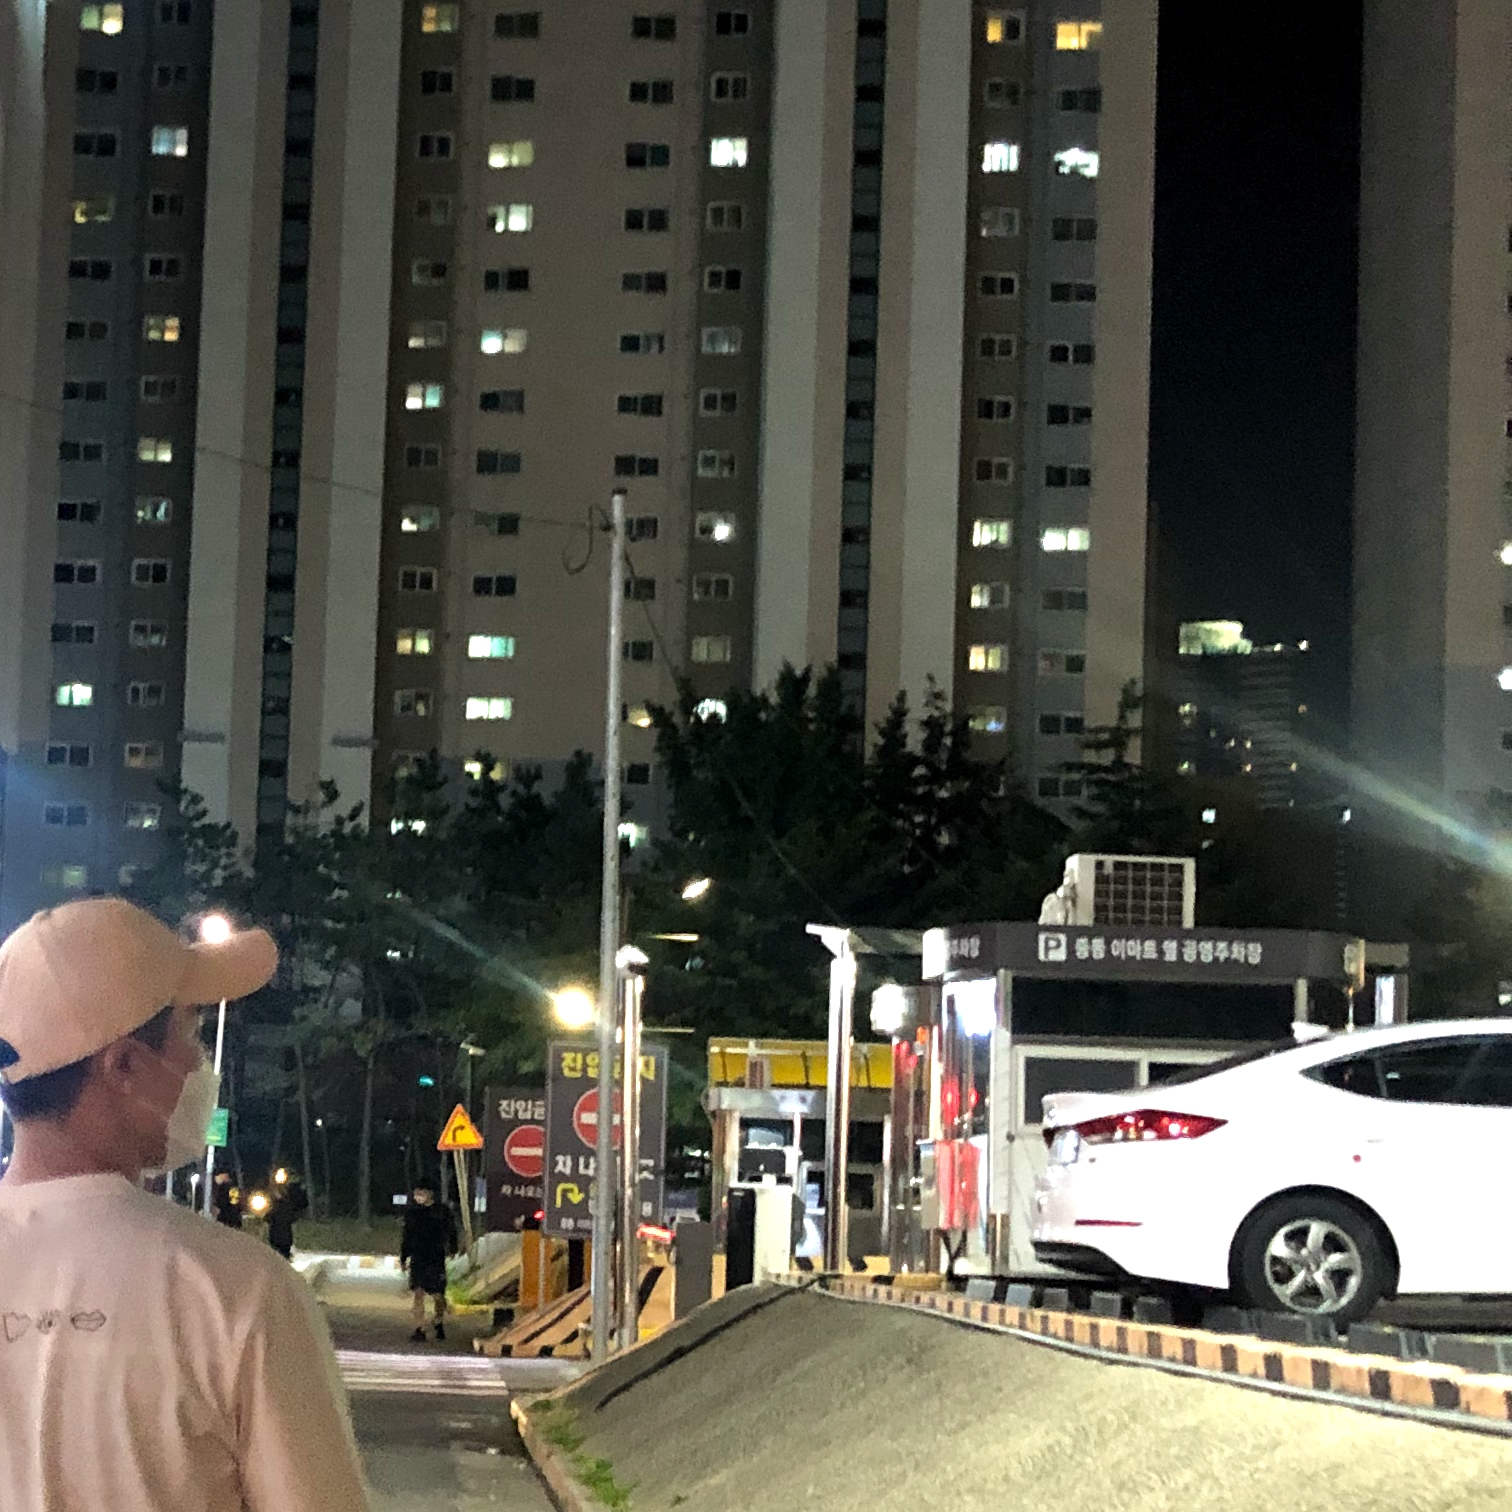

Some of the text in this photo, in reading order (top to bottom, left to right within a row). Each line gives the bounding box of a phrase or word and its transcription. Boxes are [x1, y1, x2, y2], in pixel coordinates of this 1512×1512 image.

[1040, 934, 1065, 961] P
[1110, 938, 1158, 961] 이마트
[1182, 939, 1263, 965] 공영주차장
[498, 1099, 546, 1120] 진입금
